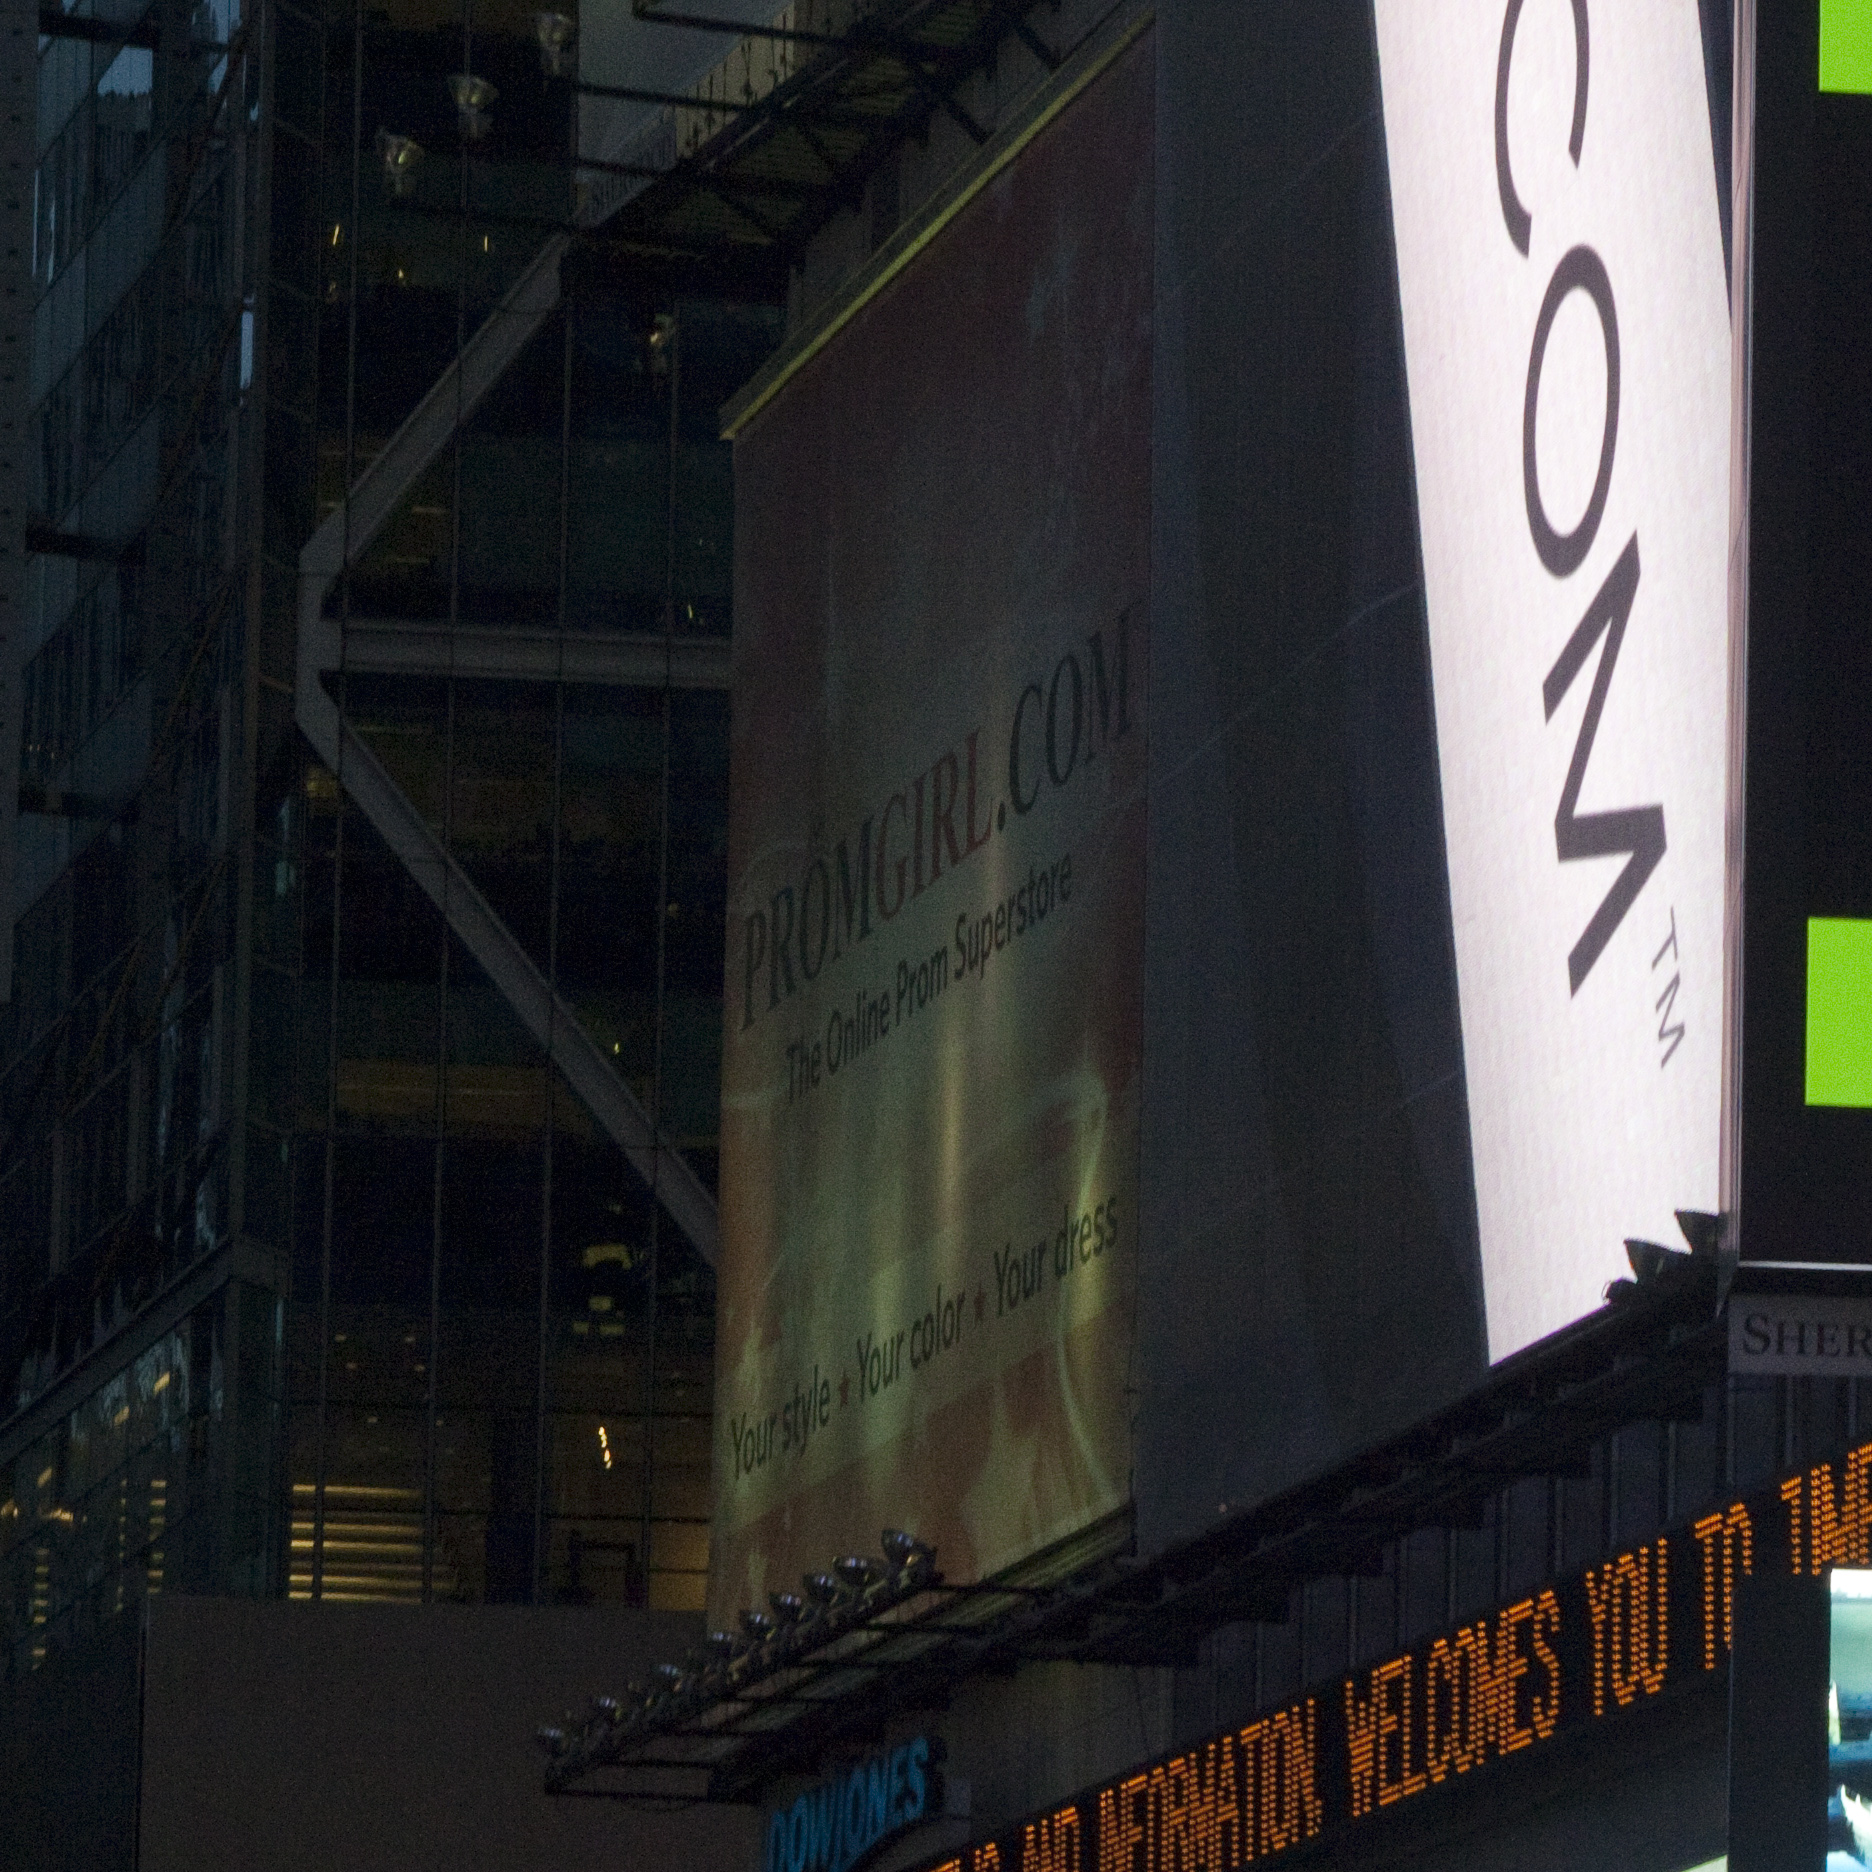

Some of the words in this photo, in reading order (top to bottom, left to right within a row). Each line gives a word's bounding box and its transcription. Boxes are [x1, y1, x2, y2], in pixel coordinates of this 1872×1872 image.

[1493, 0, 1667, 1000] COM
[733, 602, 1133, 1032] PROMGIRL.COM
[786, 1043, 820, 1099] The
[826, 990, 890, 1073] Online
[896, 953, 948, 1008] Prom
[954, 852, 1073, 981] Superstore
[730, 1414, 776, 1480] Your
[781, 1366, 830, 1455] style
[857, 1332, 902, 1402] Your
[910, 1283, 966, 1369] color
[993, 1235, 1047, 1318] Your
[1054, 1198, 1118, 1278] dress
[1344, 1589, 1561, 1818] WELCOMES
[1584, 1537, 1669, 1716] YOU
